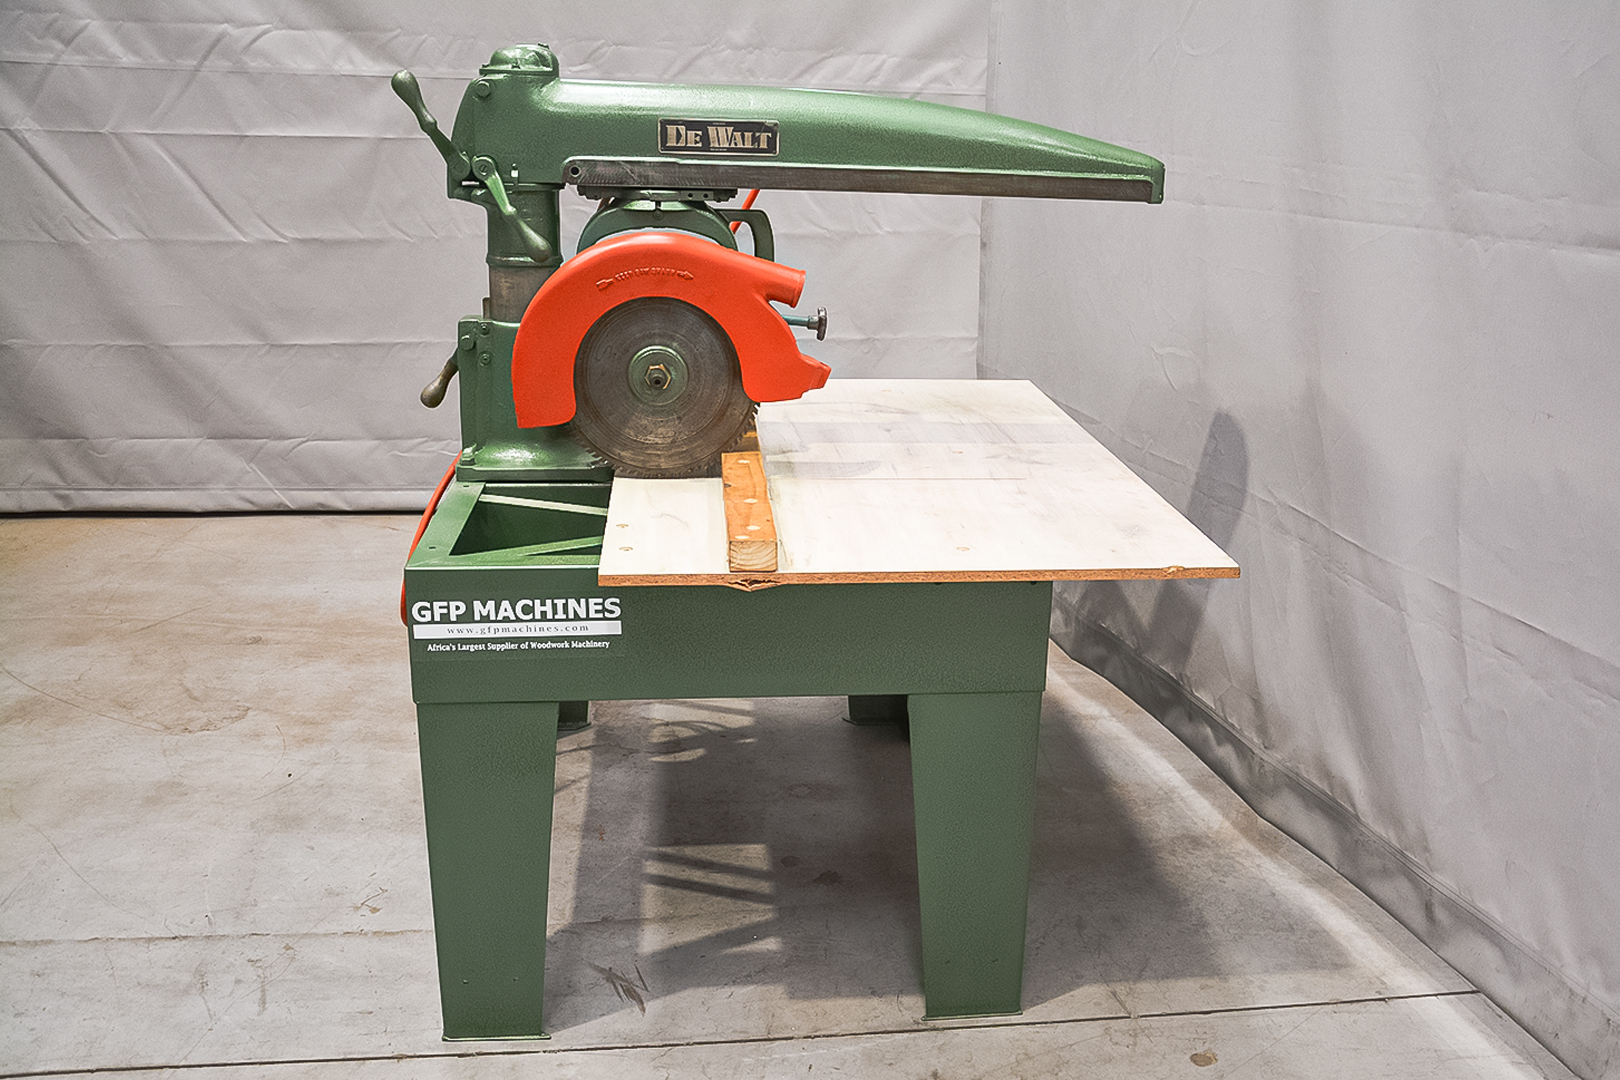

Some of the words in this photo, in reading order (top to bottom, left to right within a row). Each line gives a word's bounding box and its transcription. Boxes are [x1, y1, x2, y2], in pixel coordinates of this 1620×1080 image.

[411, 601, 467, 622] GFP
[474, 597, 622, 621] MACHINES
[446, 624, 589, 635] www.gfpmachines.com
[427, 643, 457, 651] Africa's
[457, 643, 486, 652] Largest
[487, 642, 518, 651] Supplier
[520, 641, 529, 649] of
[530, 641, 570, 649] Woodwork
[571, 640, 610, 649] Machinery
